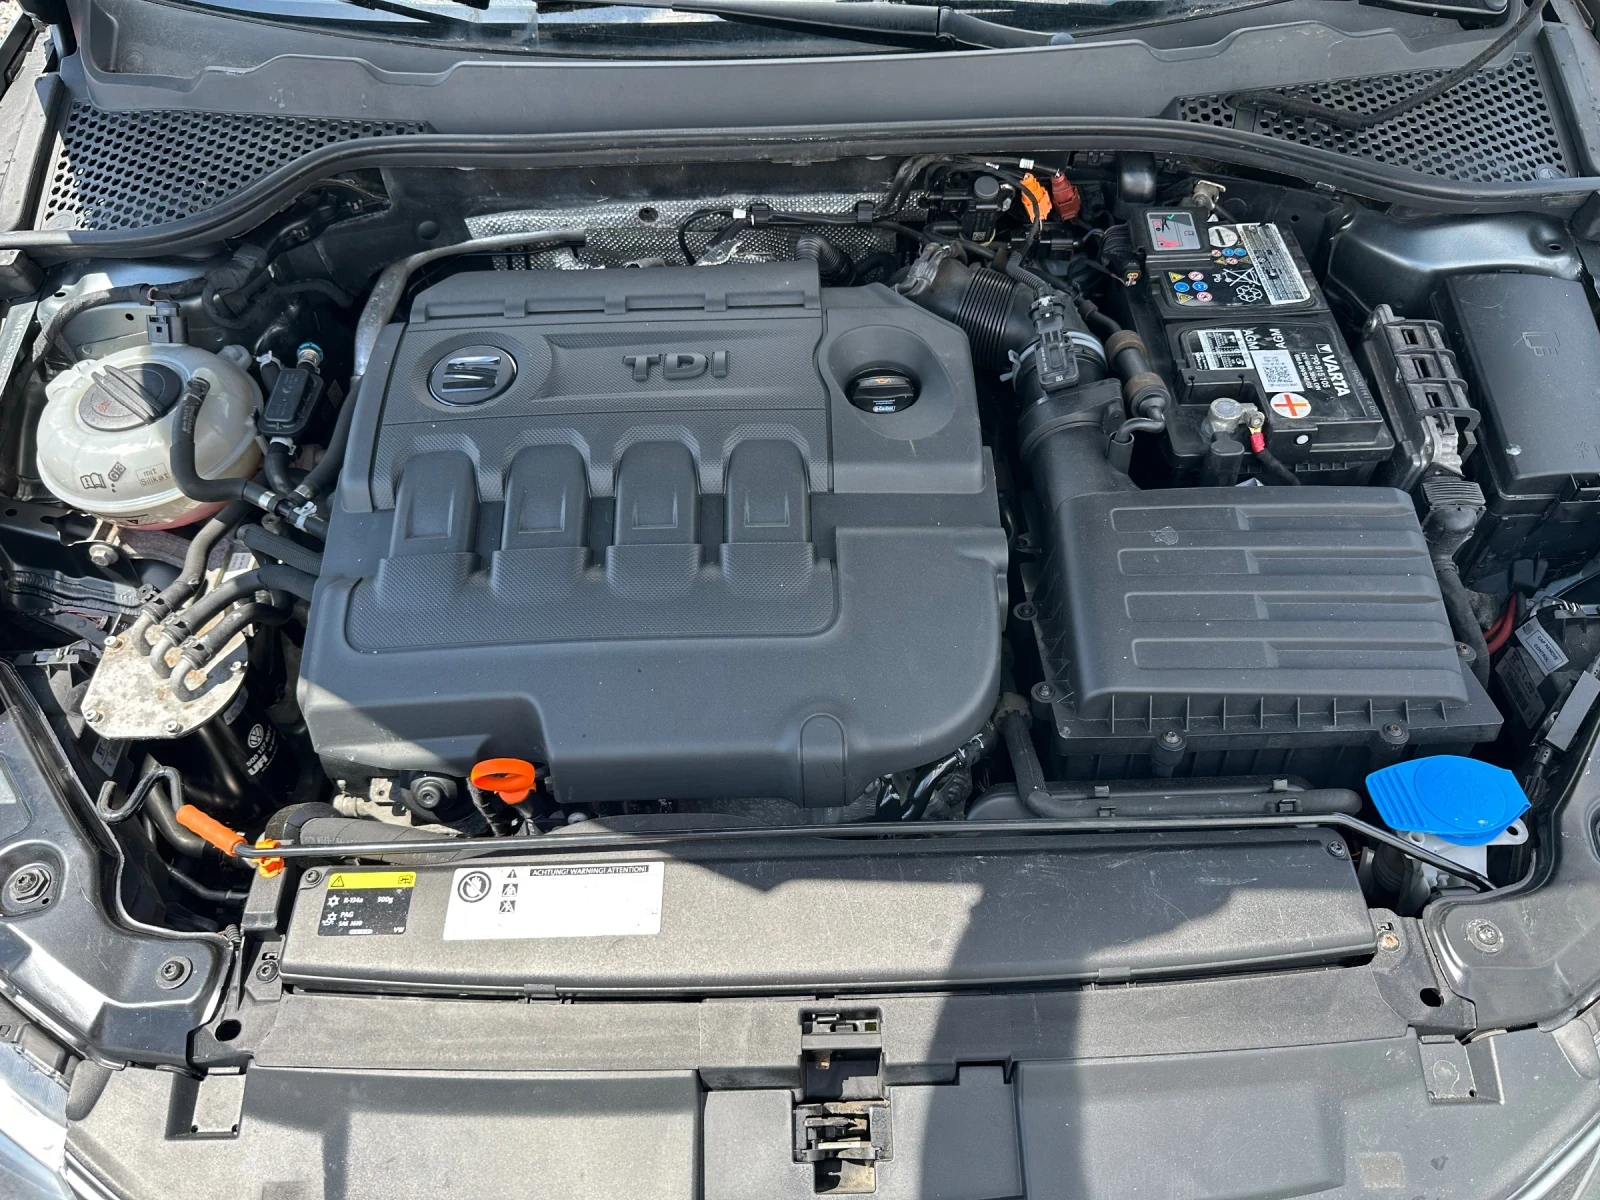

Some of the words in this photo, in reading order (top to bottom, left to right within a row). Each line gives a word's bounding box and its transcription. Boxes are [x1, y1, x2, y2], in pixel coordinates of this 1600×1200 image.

[1242, 329, 1259, 350] AGM
[1269, 328, 1287, 349] AGM
[622, 351, 730, 381] TDI
[1314, 366, 1326, 377] 915
[1321, 354, 1351, 397] VARTA
[1319, 377, 1331, 388] 105
[140, 472, 170, 487] Silikat
[143, 468, 157, 477] mit
[1533, 643, 1549, 662] CONTROL
[1537, 635, 1546, 647] CAP
[1544, 643, 1559, 661] REMOVE
[248, 754, 268, 775] UFI
[532, 867, 569, 876] ACHTUNG!
[570, 866, 606, 875] WARNING!
[607, 865, 647, 874] ATTENTION!
[340, 911, 354, 919] PAG
